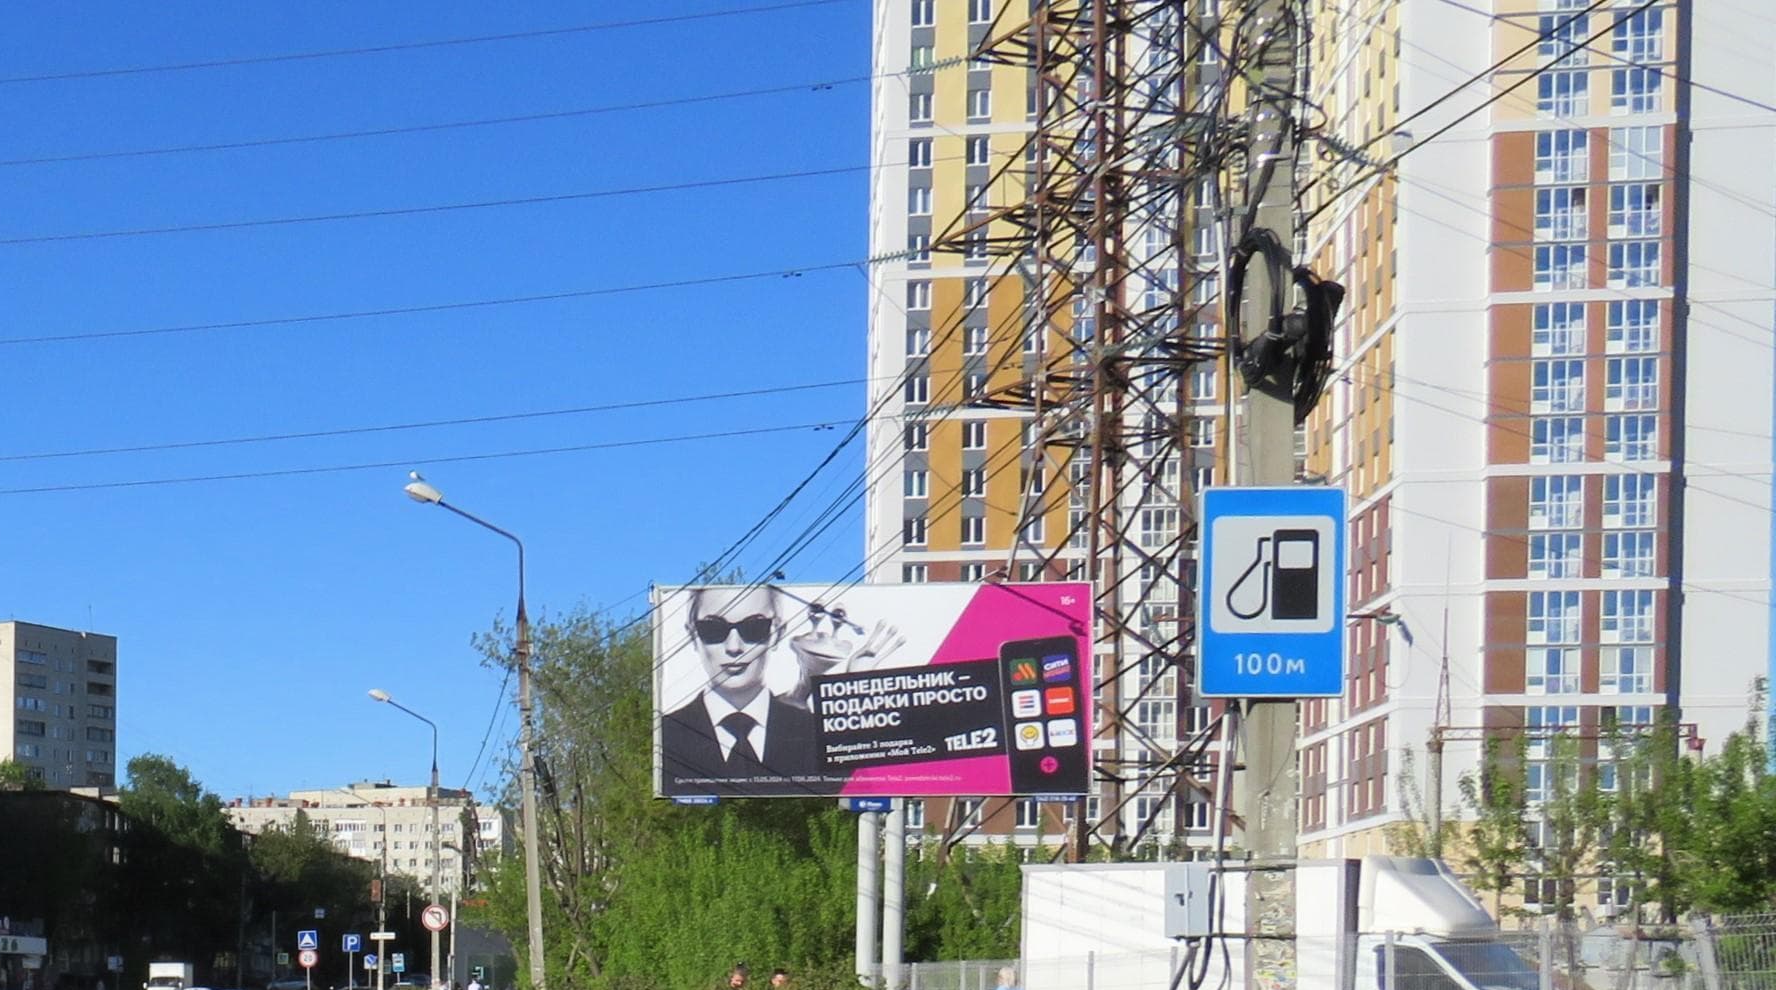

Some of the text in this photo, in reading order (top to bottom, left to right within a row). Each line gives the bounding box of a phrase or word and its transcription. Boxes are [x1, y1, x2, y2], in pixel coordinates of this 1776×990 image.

[820, 671, 955, 698] ПОНЕДЕЛЬНИК
[821, 686, 987, 715] ПОДАРКИ ПРОСТО
[823, 711, 901, 733] КОСМОС
[944, 727, 998, 751] TELE2
